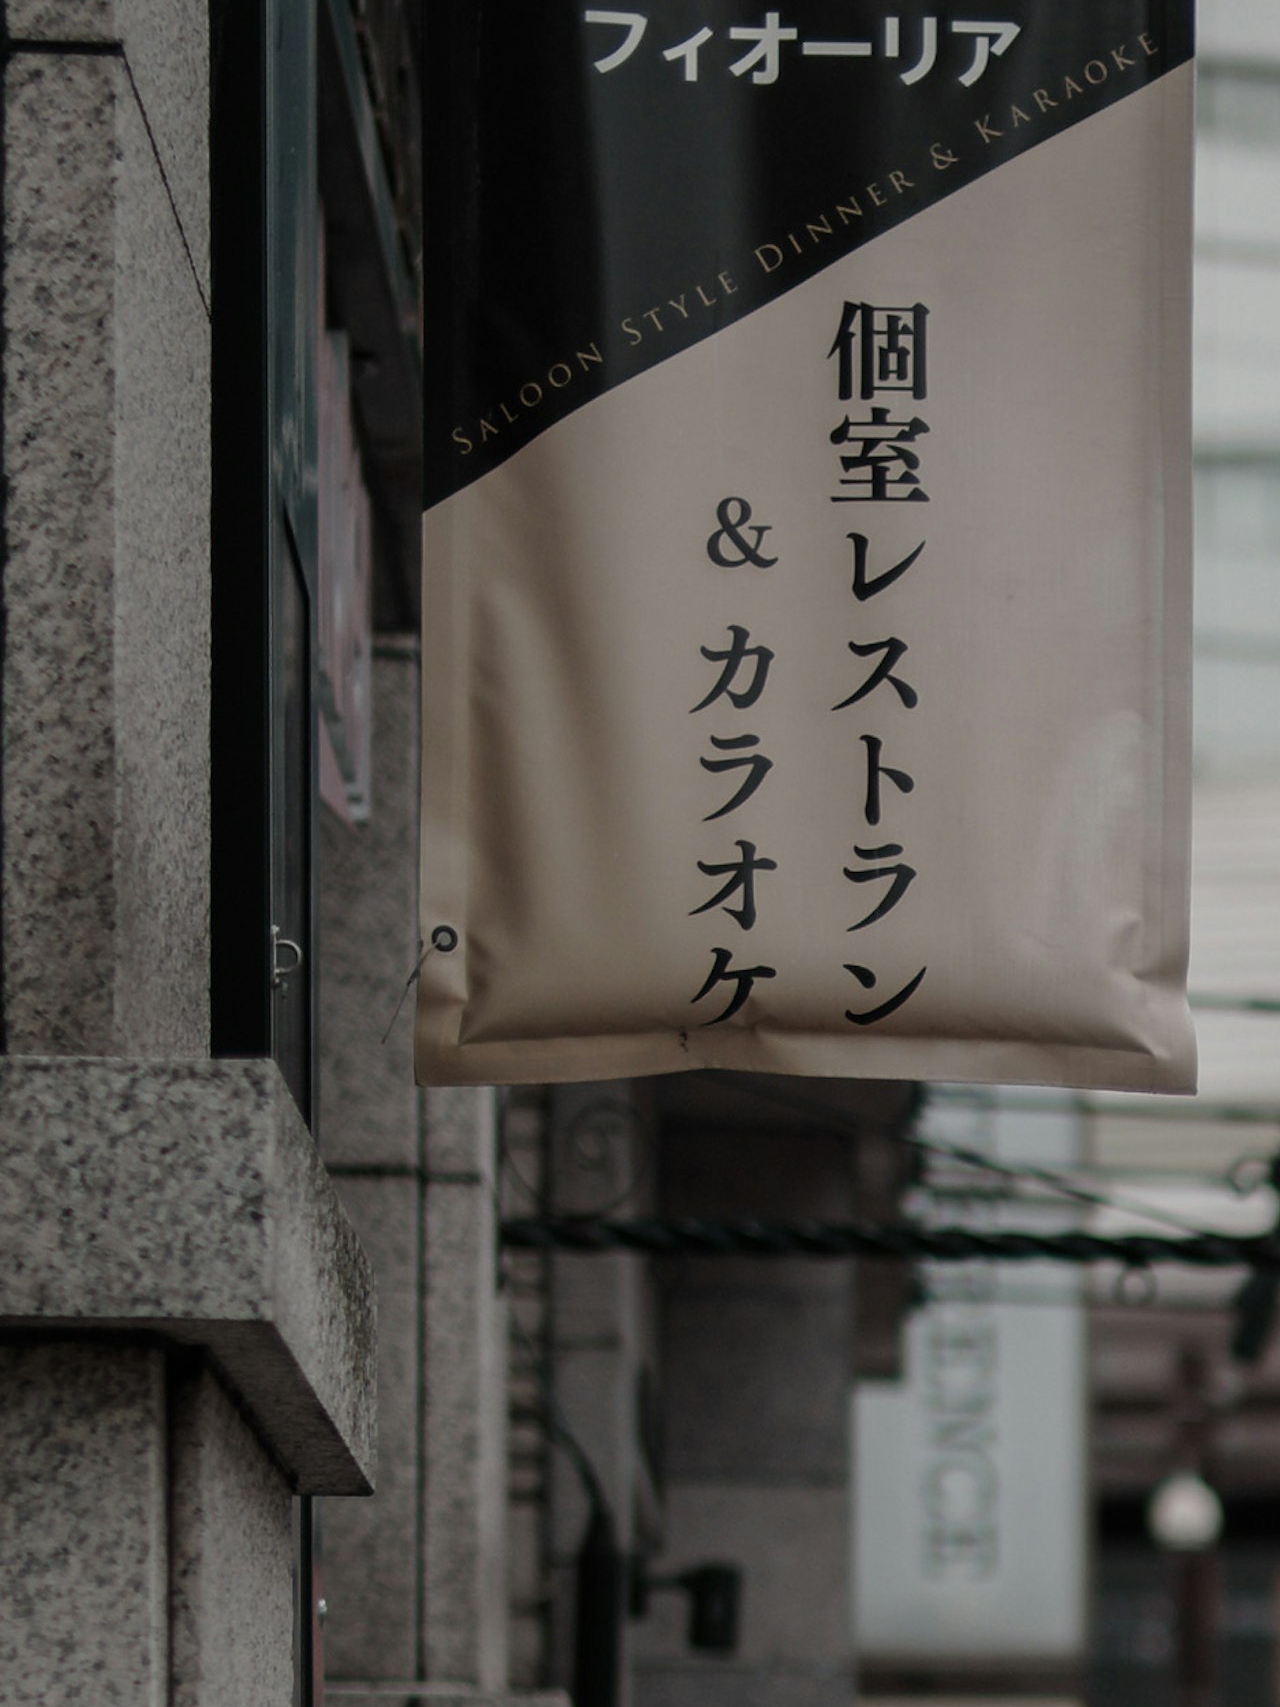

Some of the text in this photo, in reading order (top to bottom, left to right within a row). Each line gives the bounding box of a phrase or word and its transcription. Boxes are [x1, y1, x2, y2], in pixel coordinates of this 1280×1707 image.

[450, 31, 1160, 457] SALOON STYLE DINNER & KARAOKE
[584, 9, 1022, 88] フィオーリア
[826, 300, 931, 1027] 個室レストラン
